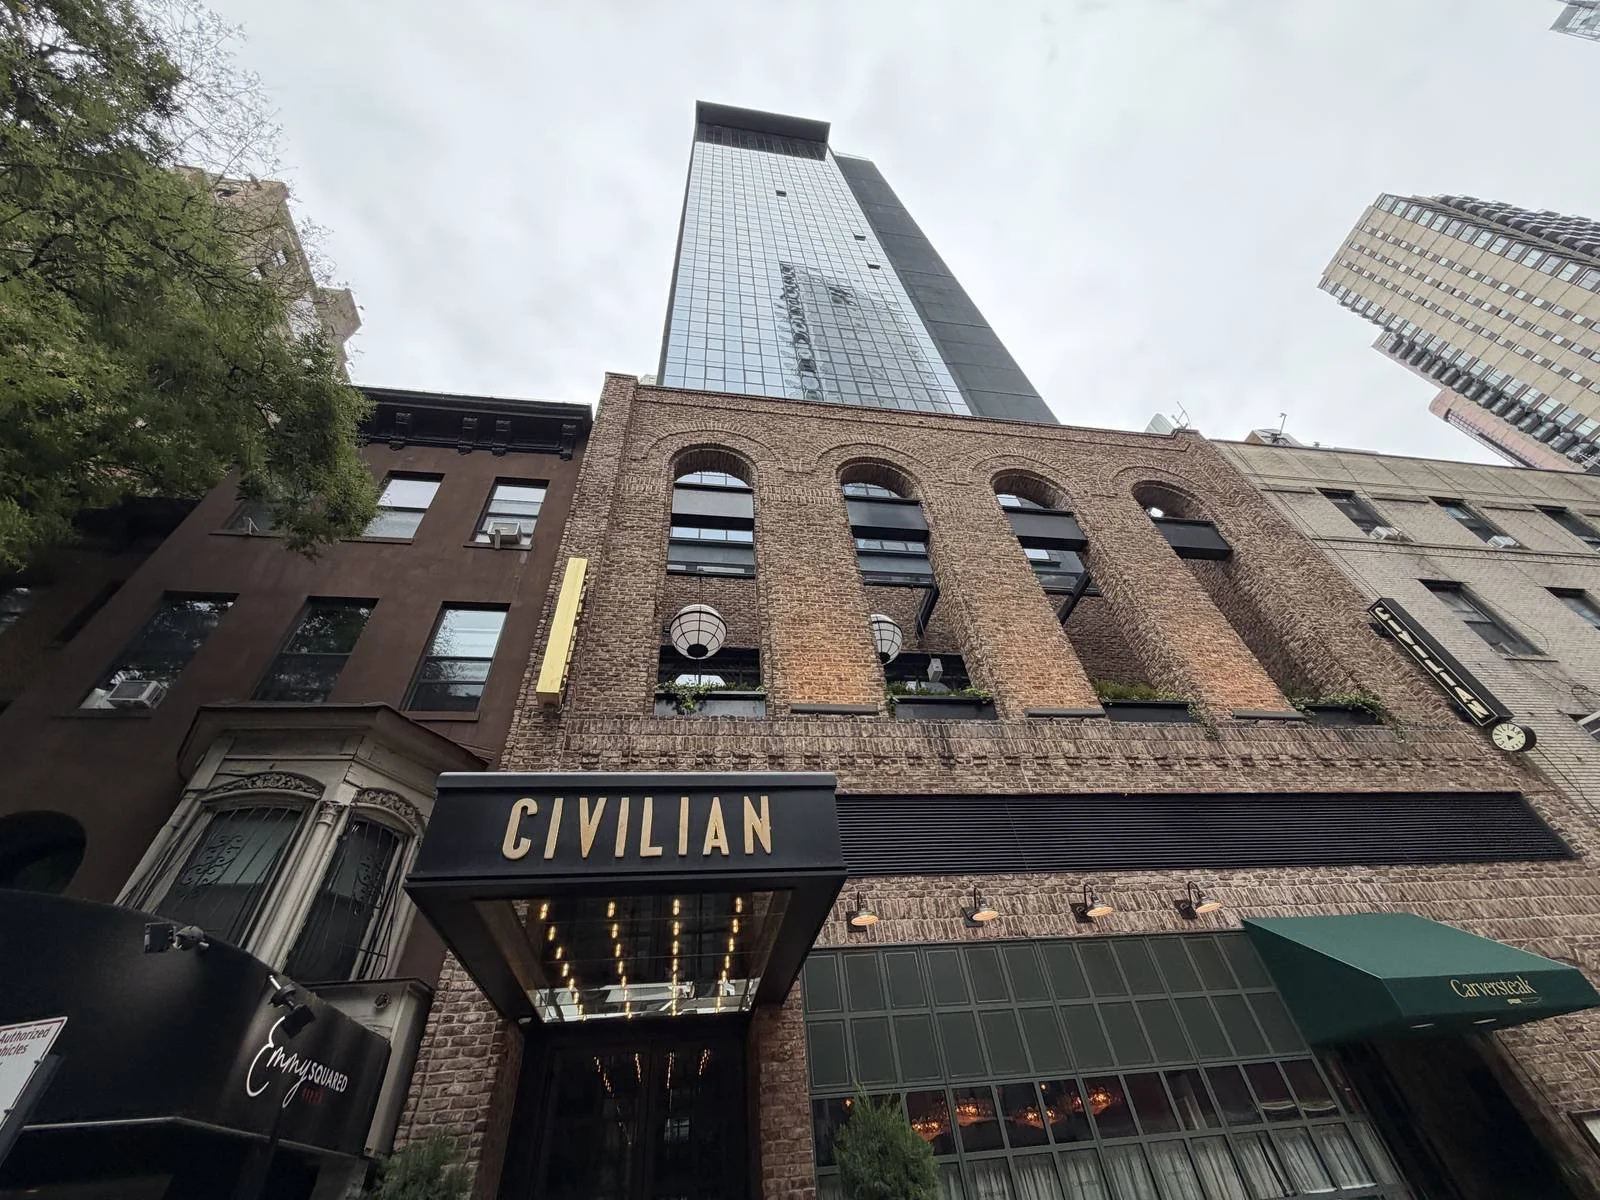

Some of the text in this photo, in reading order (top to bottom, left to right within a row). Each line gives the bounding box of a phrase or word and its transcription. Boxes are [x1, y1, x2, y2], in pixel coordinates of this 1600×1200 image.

[1375, 607, 1490, 719] CIVILIAN
[502, 796, 772, 860] CIVILIAN
[1450, 975, 1537, 998] Carversteak
[0, 1025, 53, 1044] Authorized
[246, 1015, 348, 1109] Emmy SQUARED
